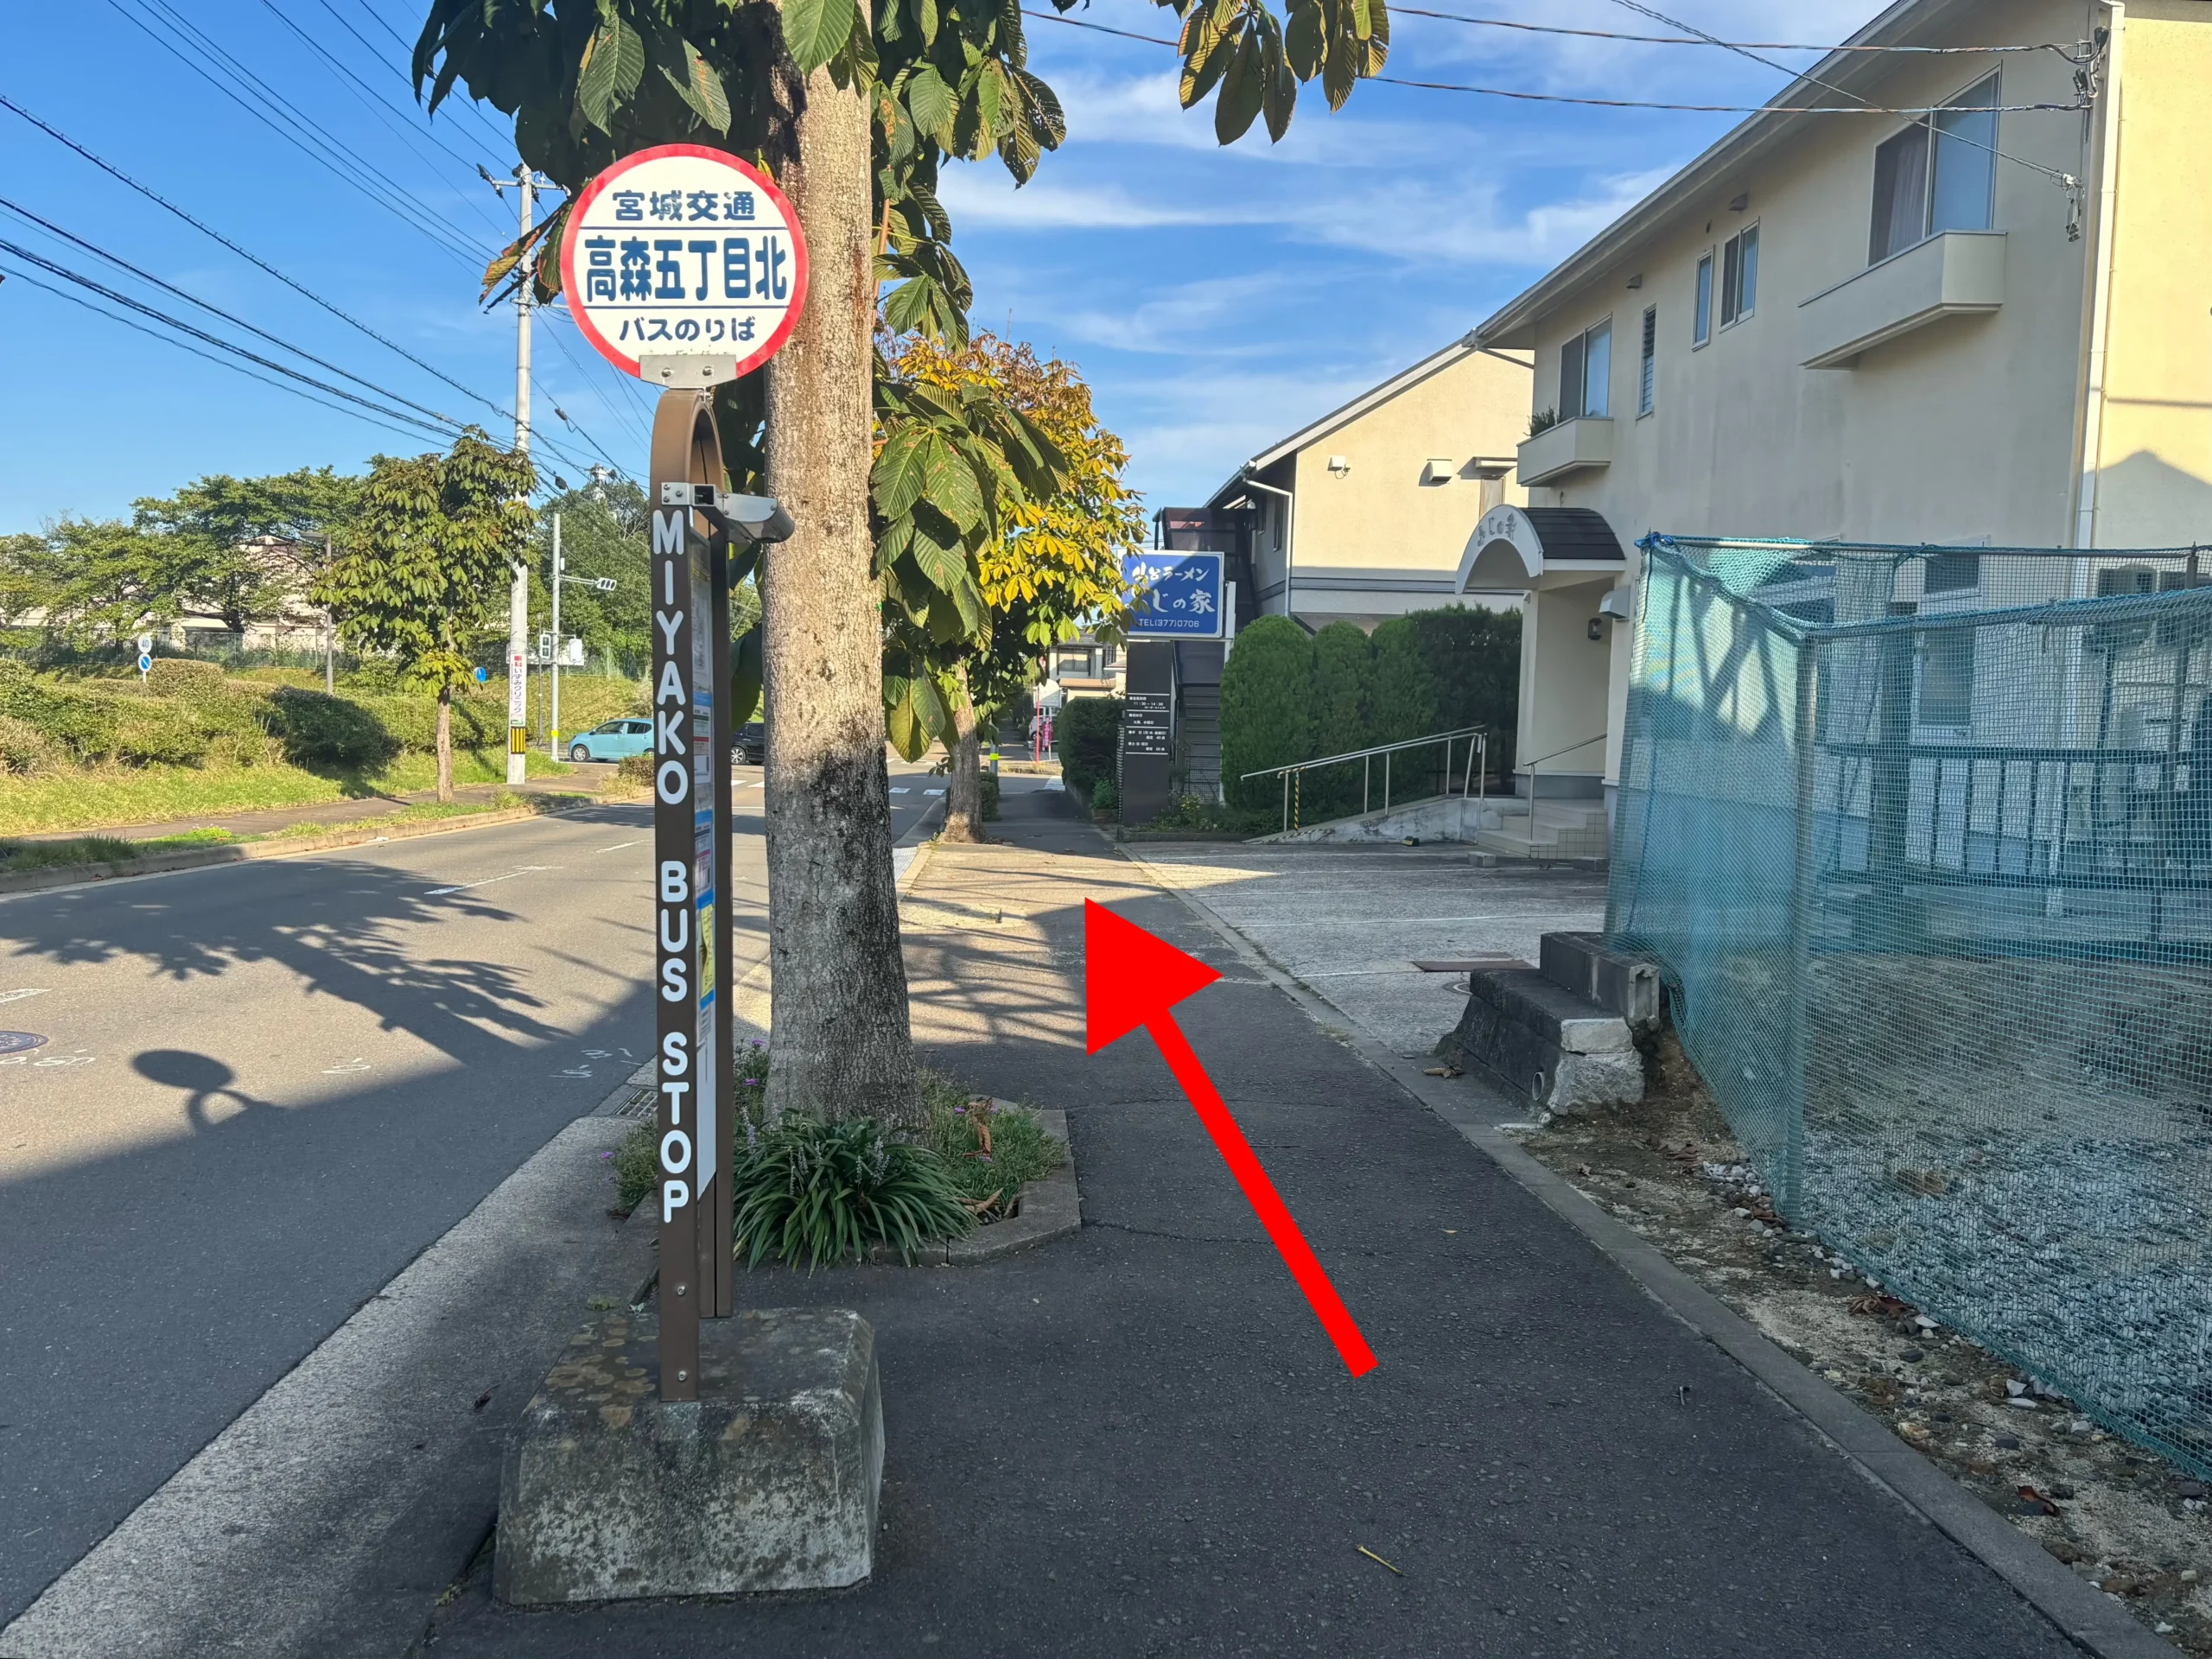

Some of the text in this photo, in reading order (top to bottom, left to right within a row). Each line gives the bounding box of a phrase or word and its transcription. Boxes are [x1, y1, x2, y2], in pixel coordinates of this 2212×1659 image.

[612, 189, 756, 222] 宮城交通
[584, 235, 787, 302] 高森五丁目北
[619, 316, 756, 342] バスのりば
[1130, 588, 1216, 614] じの家
[141, 639, 149, 648] 40
[652, 509, 692, 1224] MIYAKO BUS STOP
